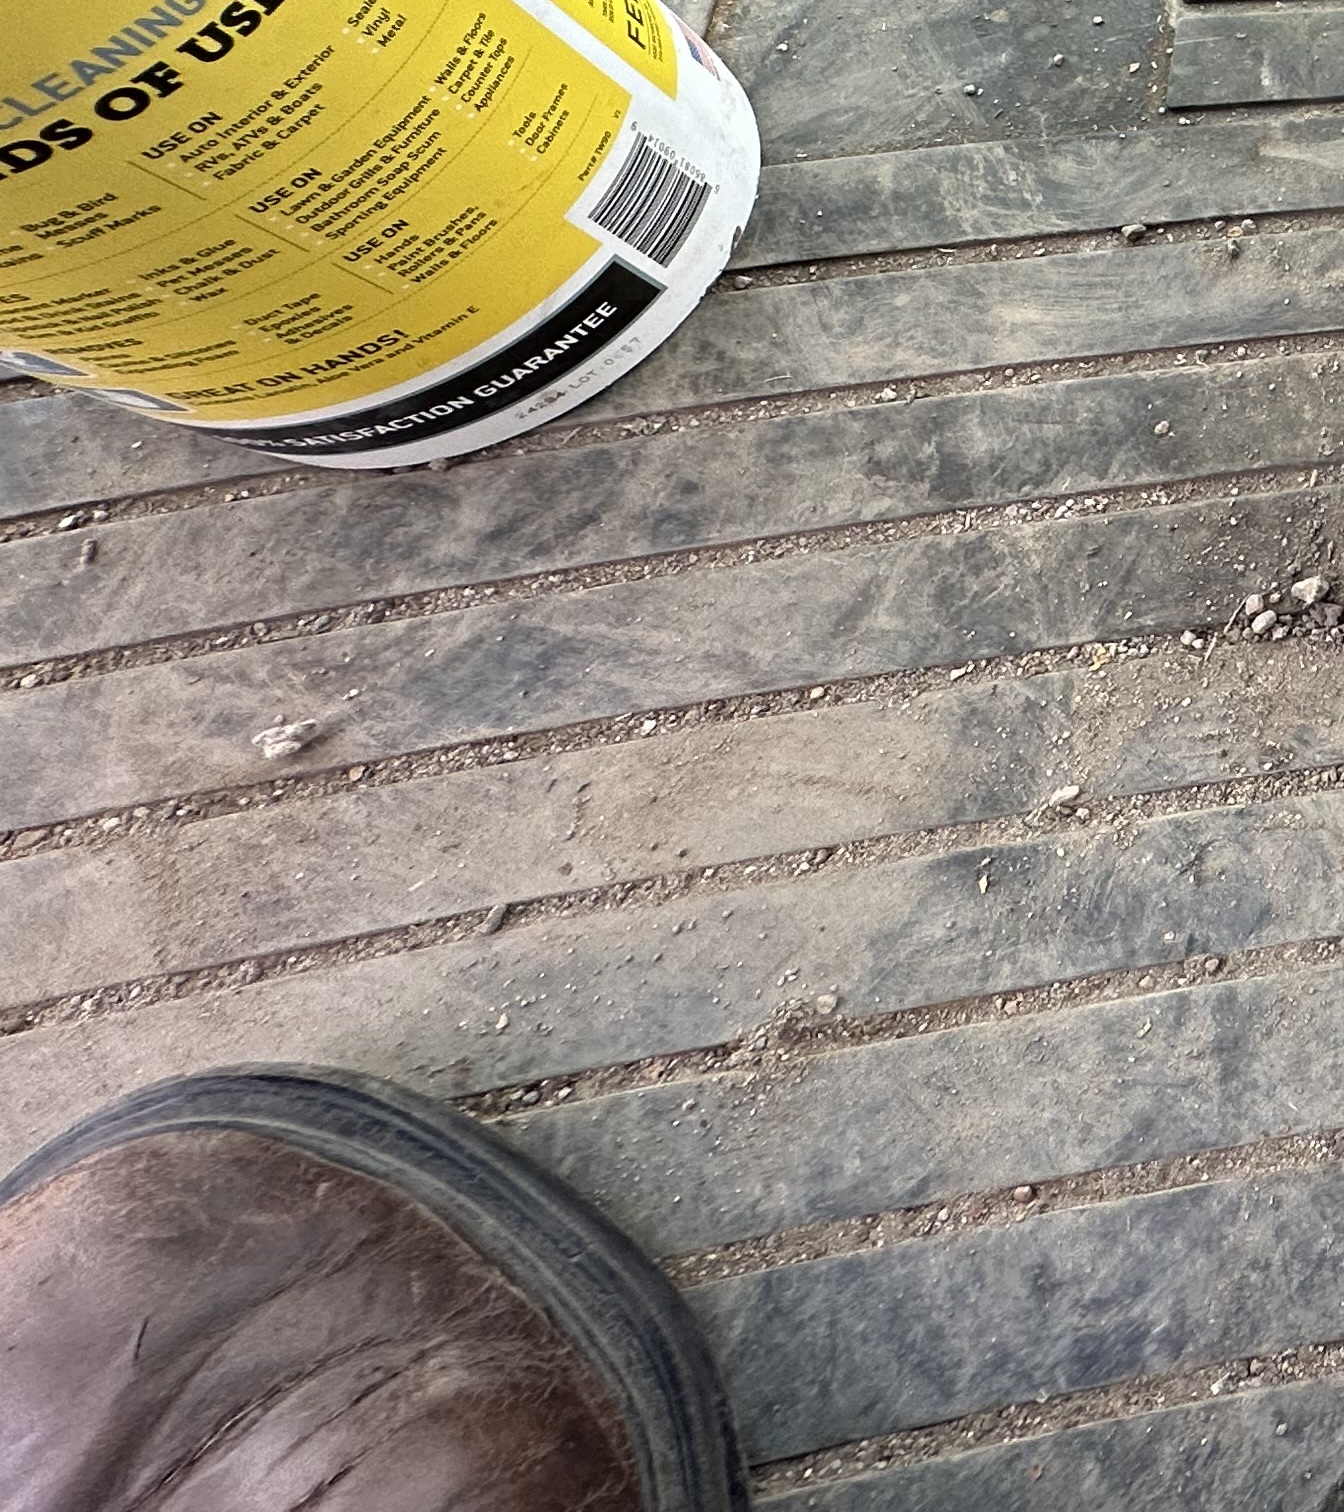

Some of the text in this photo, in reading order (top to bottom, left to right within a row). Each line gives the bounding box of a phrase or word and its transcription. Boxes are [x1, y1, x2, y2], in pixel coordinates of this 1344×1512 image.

[362, 7, 391, 37] Vinyl
[377, 13, 408, 48] Metal
[434, 12, 487, 85] Walls & Floors
[447, 29, 496, 95] Carpet & Tile
[460, 38, 508, 103] Counter Tops
[180, 45, 336, 163] Auto Interior & Exterior
[473, 55, 515, 112] Appliances
[0, 118, 94, 181] DS
[94, 61, 184, 121] OF
[141, 111, 223, 160] USE ON
[194, 82, 323, 173] RVs, ATVs & Boats
[512, 111, 537, 138] Tools
[524, 83, 569, 147] Door Frames
[536, 110, 570, 155] Cabinets
[213, 102, 326, 181] Fabric & Carpet
[279, 95, 432, 216] Lawn & Garden Equipment
[295, 108, 441, 224] Outdoor Grills & Furniture
[249, 167, 323, 214] USE ON
[310, 131, 442, 232] Bathroom Soap Scum
[325, 147, 448, 240] Sporting Equipment
[19, 192, 119, 233] Bug & Bird
[35, 212, 109, 240] Messes
[56, 205, 162, 249] Scuff Marks
[138, 239, 236, 281] Inks & Glue
[342, 219, 410, 262] USE ON
[373, 234, 420, 264] Hands
[387, 247, 425, 271] Paint
[397, 211, 488, 277] Rollers & Pans
[410, 219, 498, 283] Walls & Floors
[156, 247, 254, 288] Pet Messes
[173, 248, 281, 295] Chalk & Dust
[243, 292, 323, 326] Duct Tape
[258, 306, 322, 332] Epoxies
[275, 303, 354, 339] Adhesives
[284, 315, 353, 345] & Decals
[384, 343, 416, 360] and
[413, 313, 468, 345] Vitamin
[466, 304, 480, 315] E
[165, 382, 256, 401] GREAT
[256, 371, 304, 388] ON
[300, 329, 410, 376] HANDS!
[283, 301, 618, 448] SATISFACTION GUARANTEE
